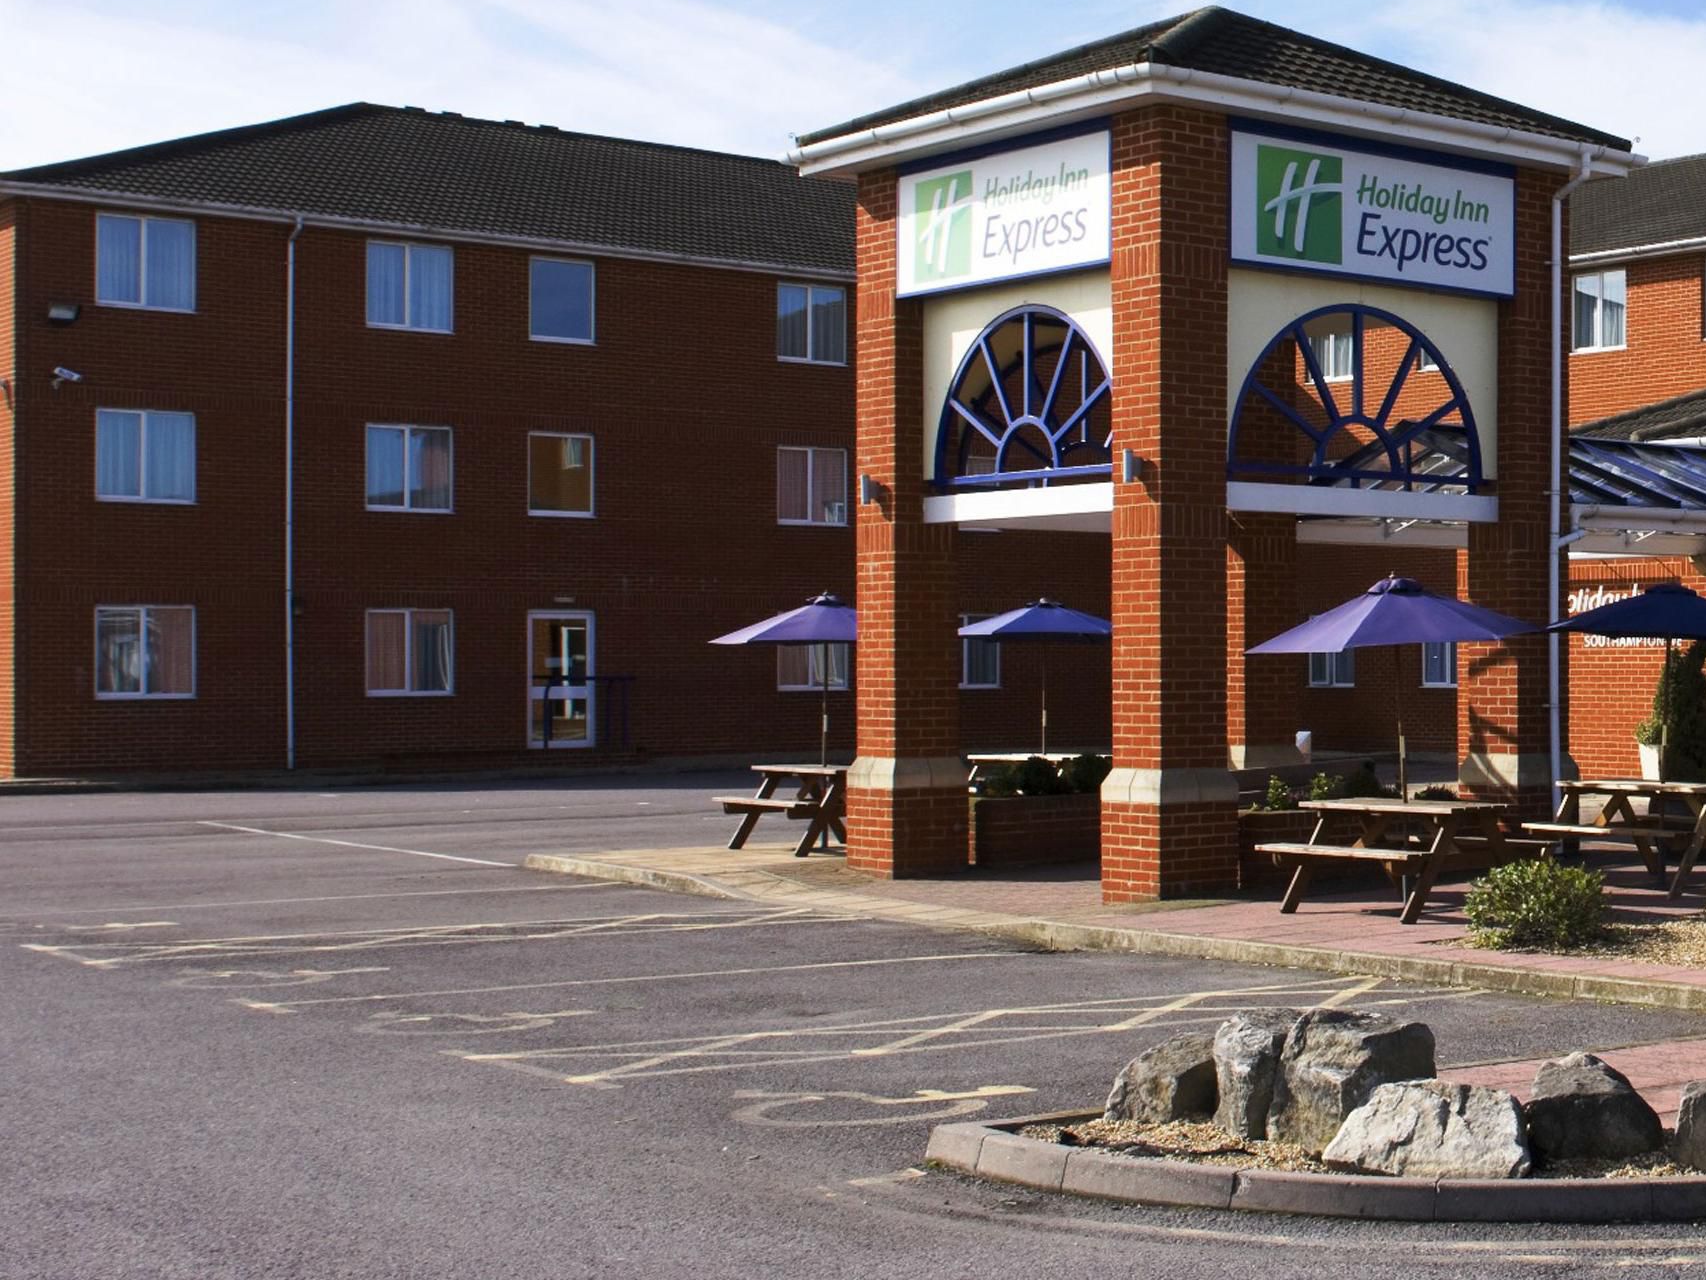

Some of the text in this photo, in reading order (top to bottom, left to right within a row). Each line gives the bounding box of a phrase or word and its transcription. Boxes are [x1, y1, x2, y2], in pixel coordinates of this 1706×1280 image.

[984, 162, 1089, 205] Holiday Inn
[1356, 174, 1489, 224] Holiday Inn
[983, 208, 1087, 264] Express
[1356, 212, 1490, 272] Express
[1567, 585, 1629, 614] olida
